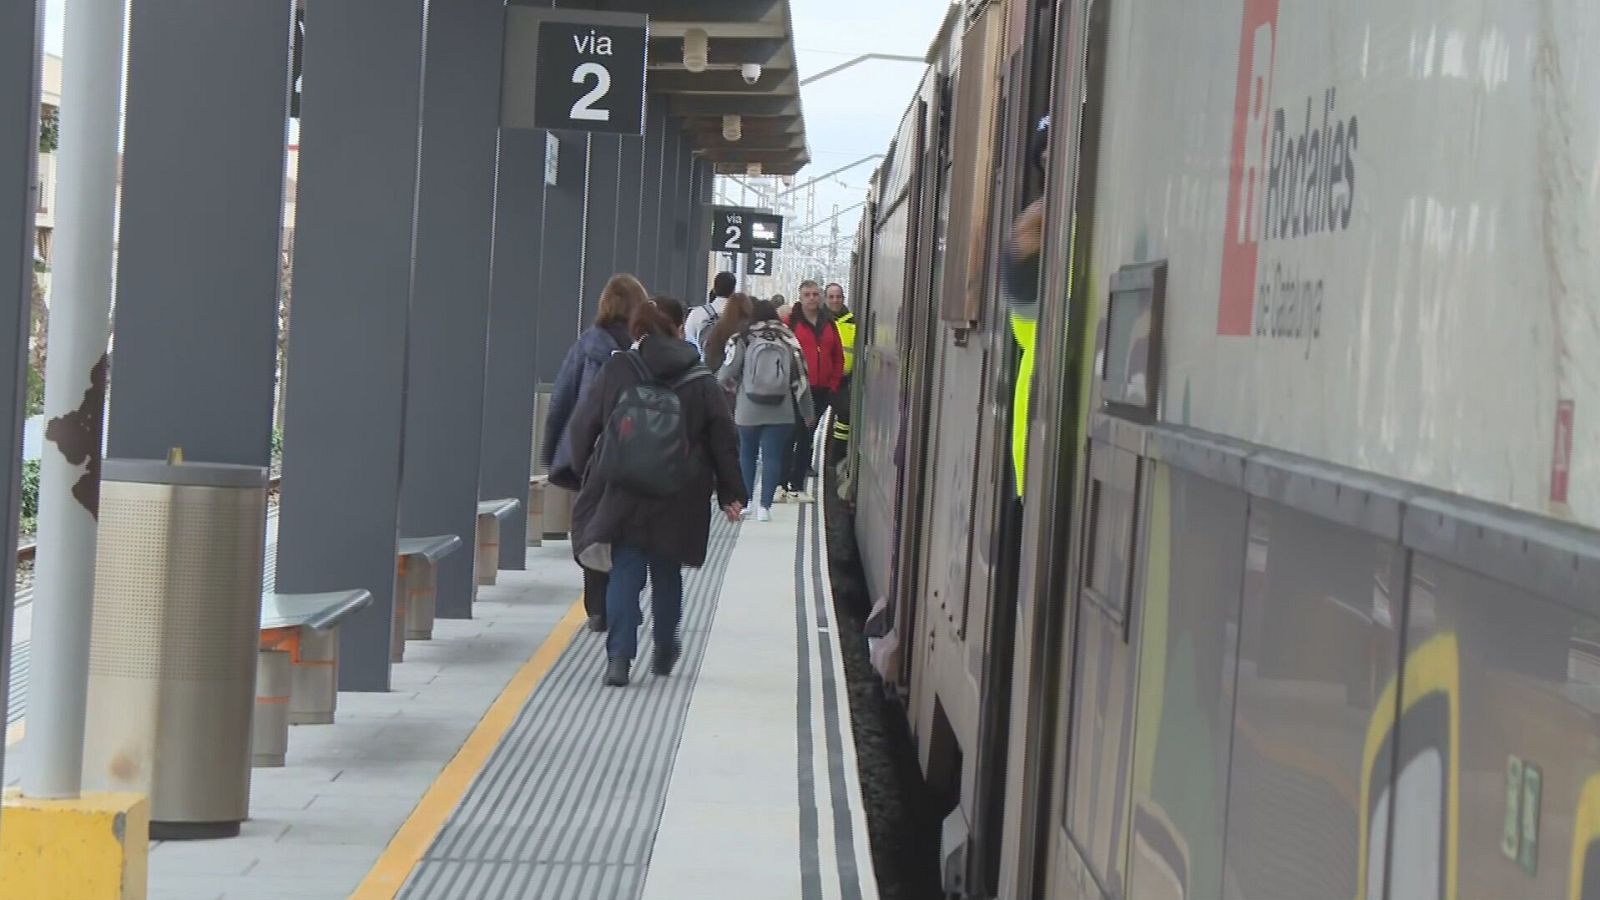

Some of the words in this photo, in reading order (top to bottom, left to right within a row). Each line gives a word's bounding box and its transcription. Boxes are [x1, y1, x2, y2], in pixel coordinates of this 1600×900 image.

[573, 30, 613, 56] via
[569, 62, 612, 121] 2
[1264, 86, 1358, 240] Rodalies
[726, 212, 743, 224] via
[724, 225, 742, 249] 2
[753, 258, 767, 274] 2
